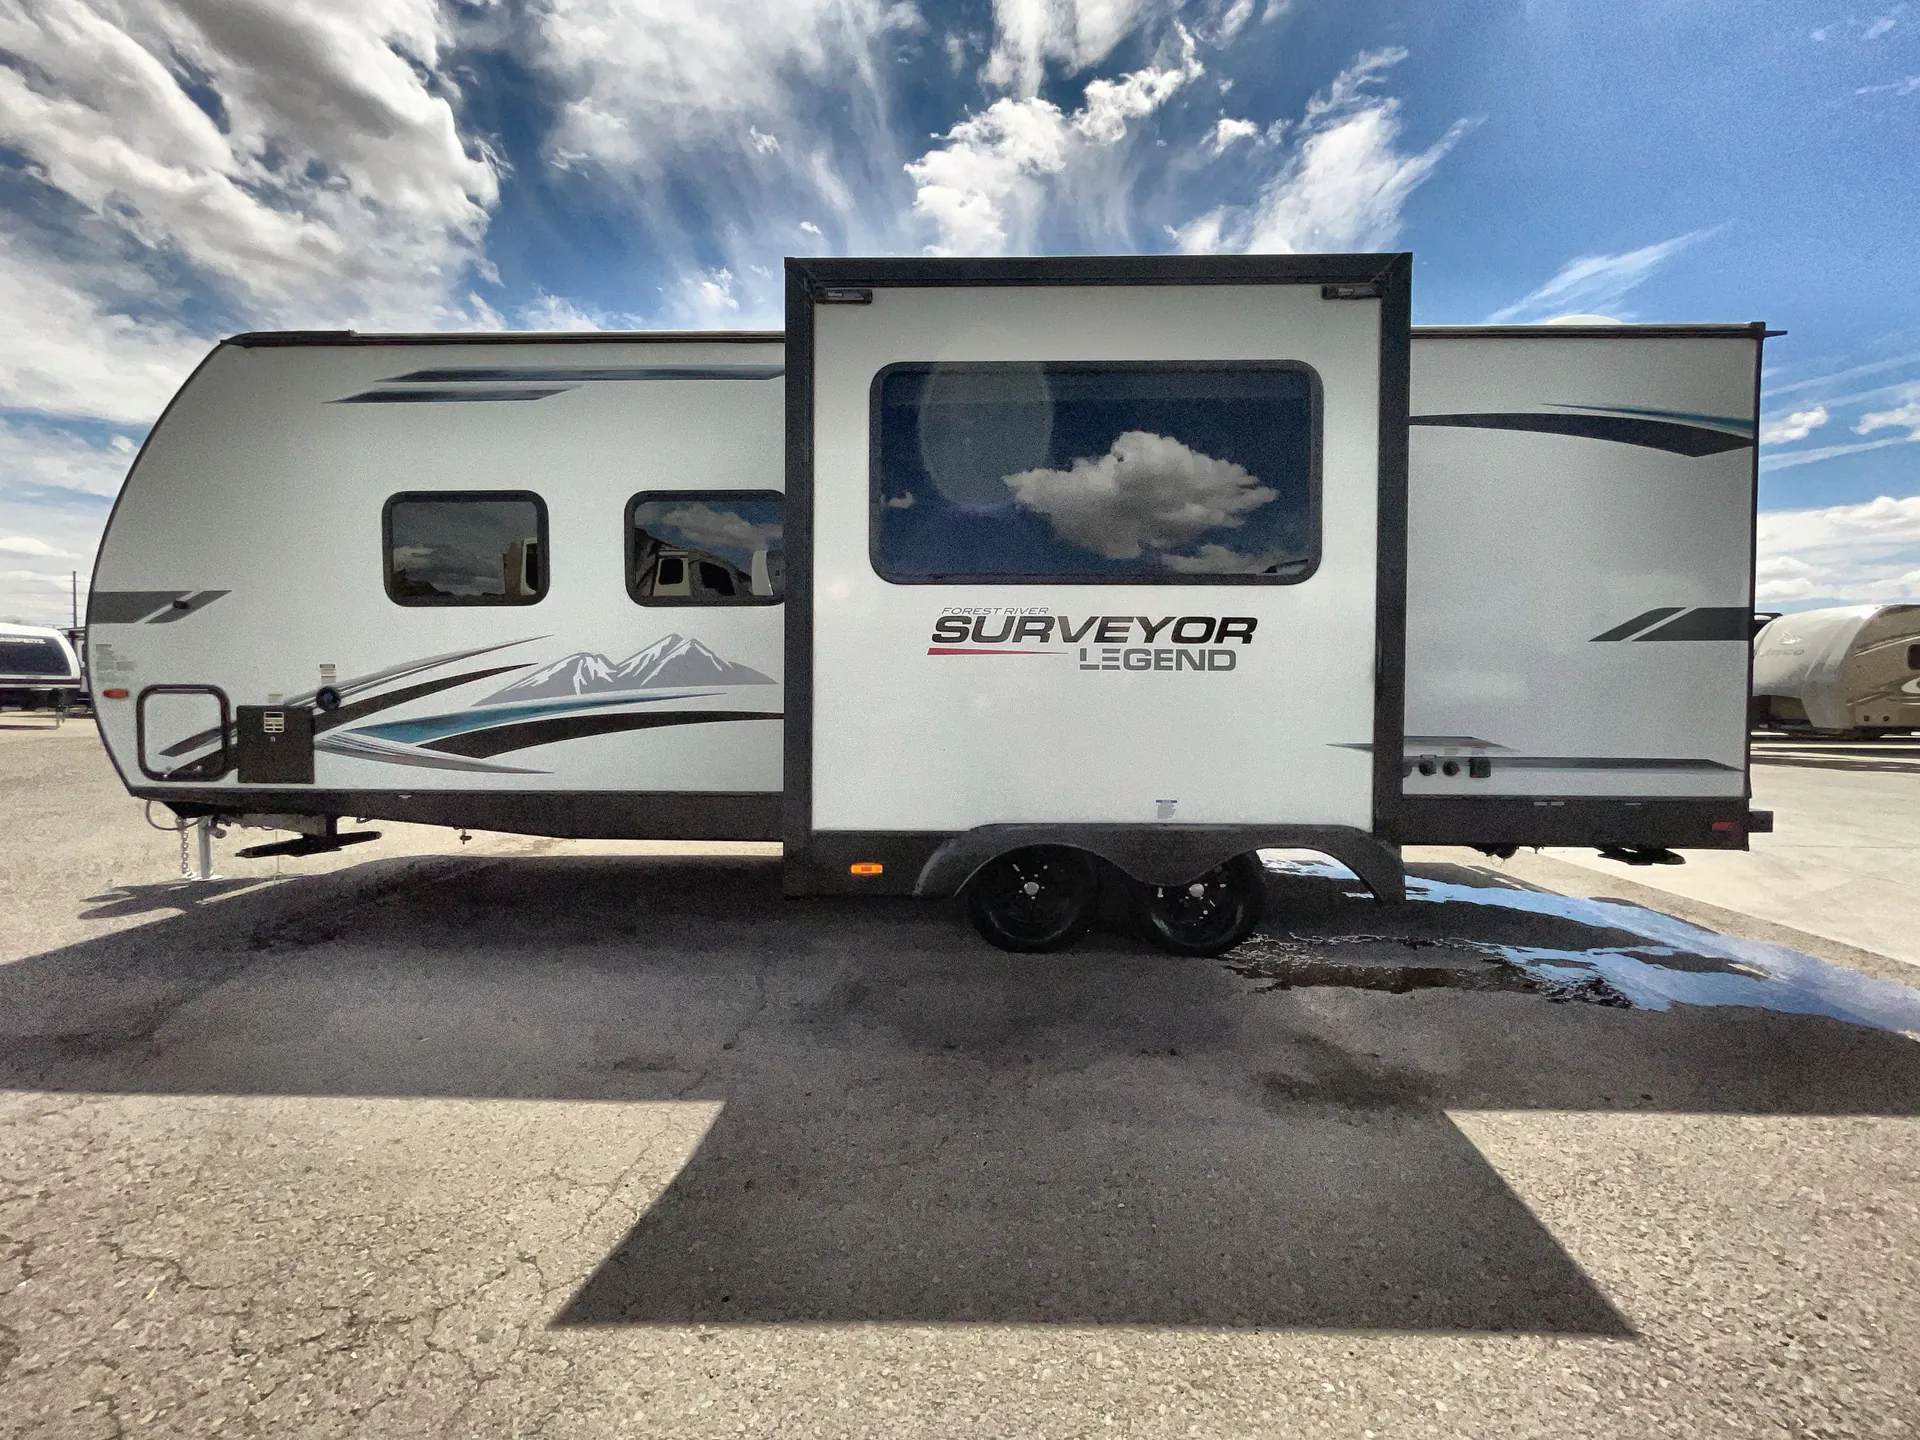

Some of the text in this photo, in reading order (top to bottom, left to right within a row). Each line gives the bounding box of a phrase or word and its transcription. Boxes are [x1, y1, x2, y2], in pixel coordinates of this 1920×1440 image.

[941, 607, 1049, 615] FOREST RIVER
[931, 615, 1258, 644] SURVEYOR
[1079, 647, 1237, 671] LEGEND
